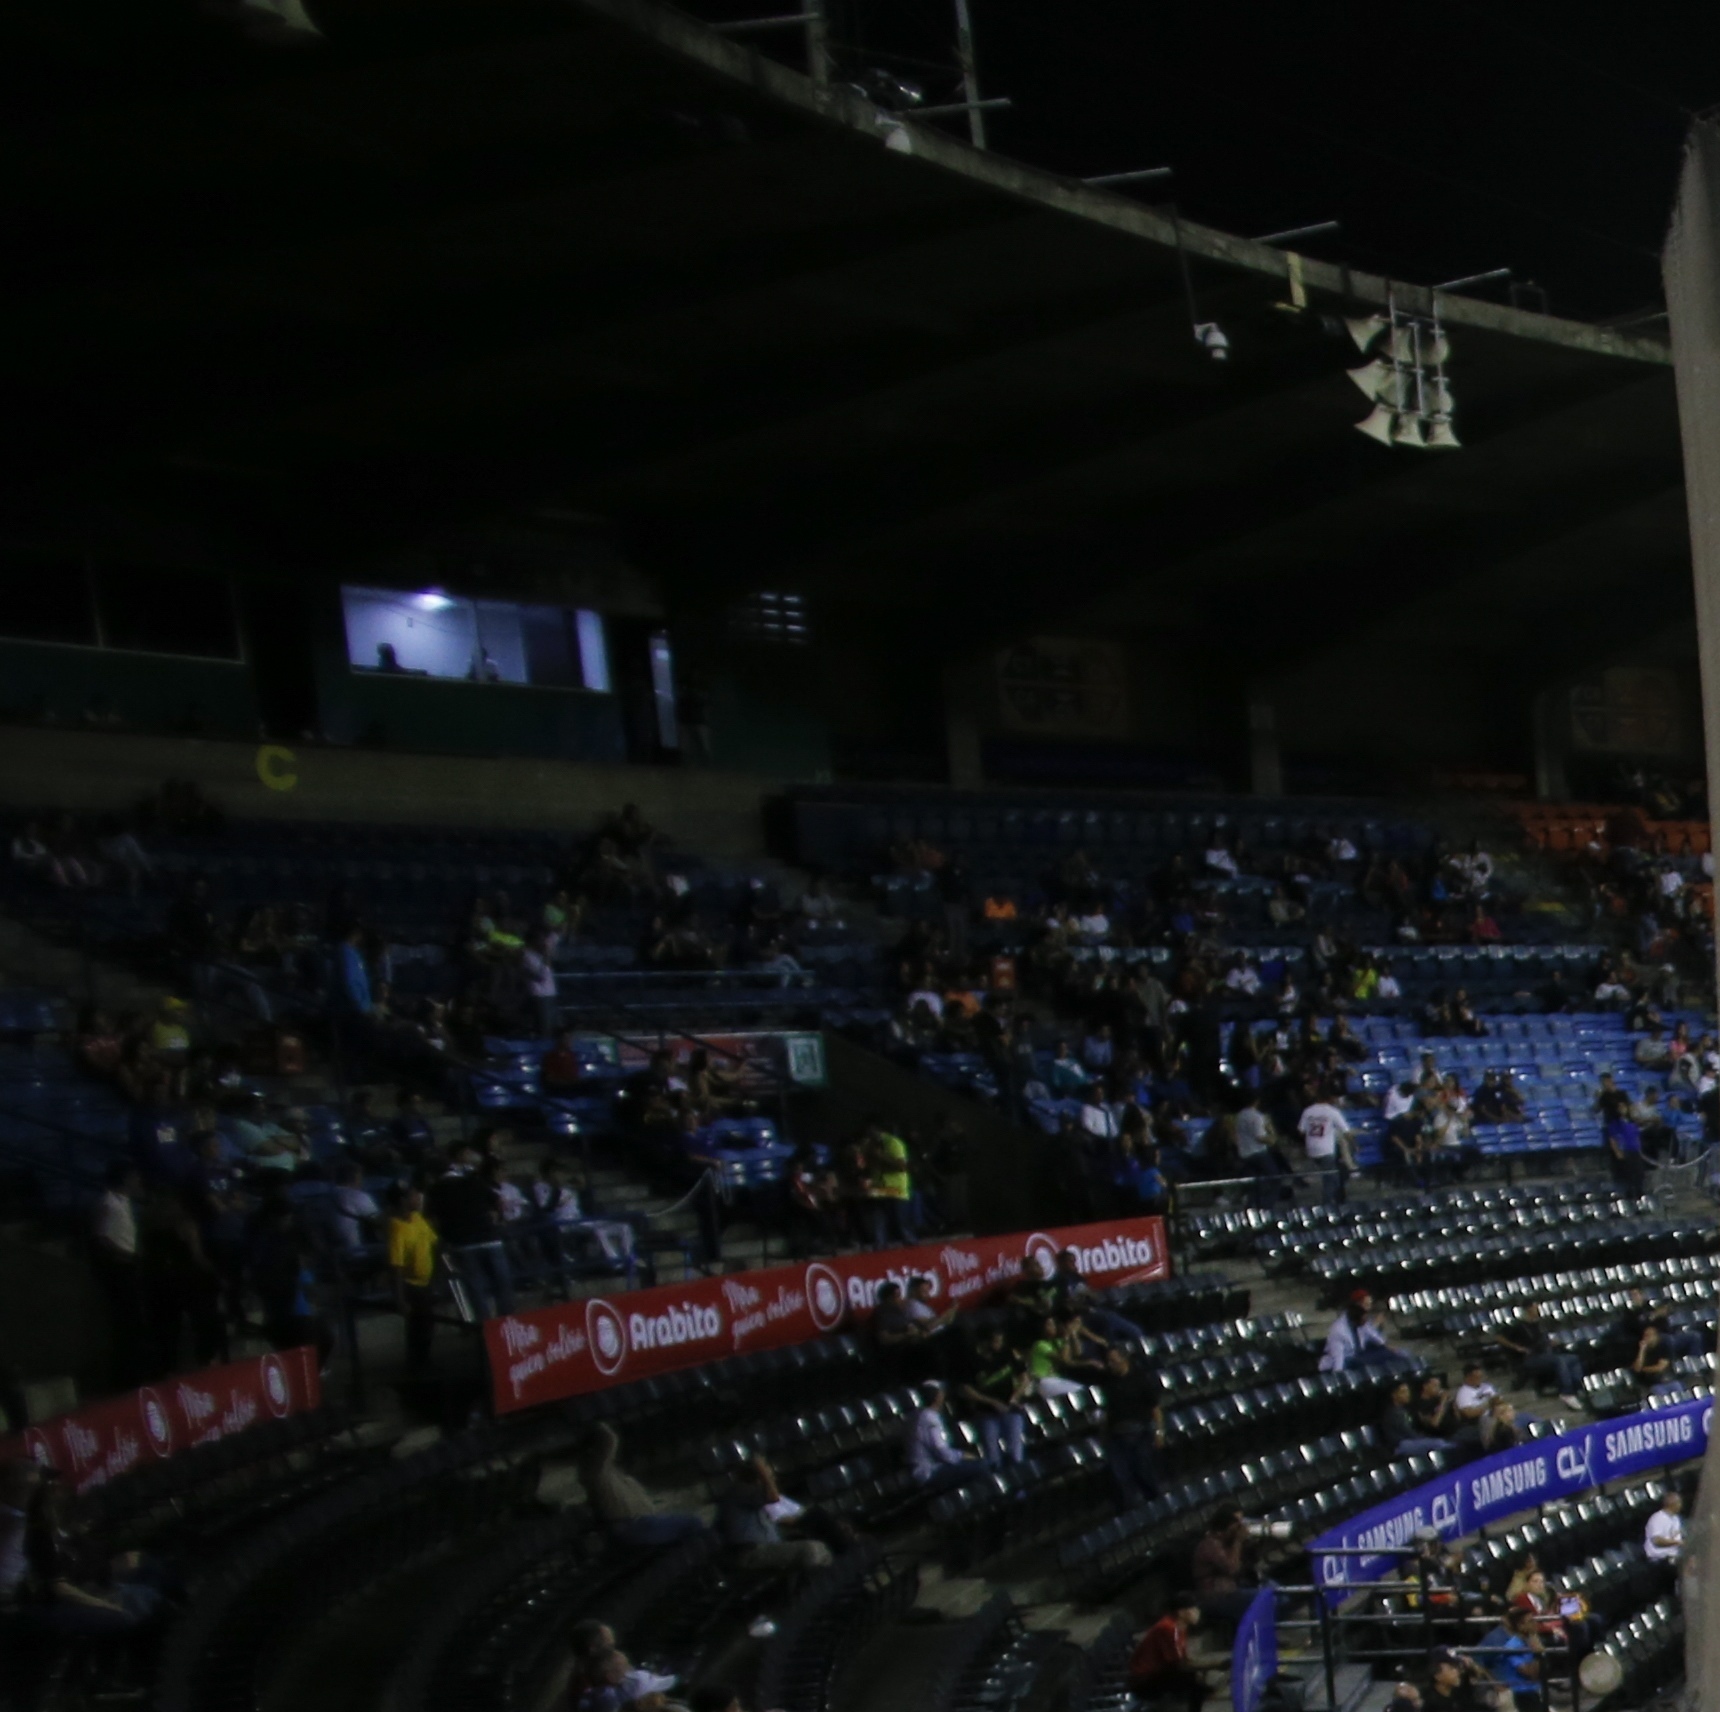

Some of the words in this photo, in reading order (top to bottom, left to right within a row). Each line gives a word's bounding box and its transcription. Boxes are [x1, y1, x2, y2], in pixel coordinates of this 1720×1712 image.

[256, 744, 298, 791] C
[629, 1300, 721, 1351] Arabito
[1357, 1505, 1425, 1568] SAMSUNG
[1471, 1456, 1548, 1511] SAMSUNG
[1605, 1413, 1693, 1463] SAMSUNG
